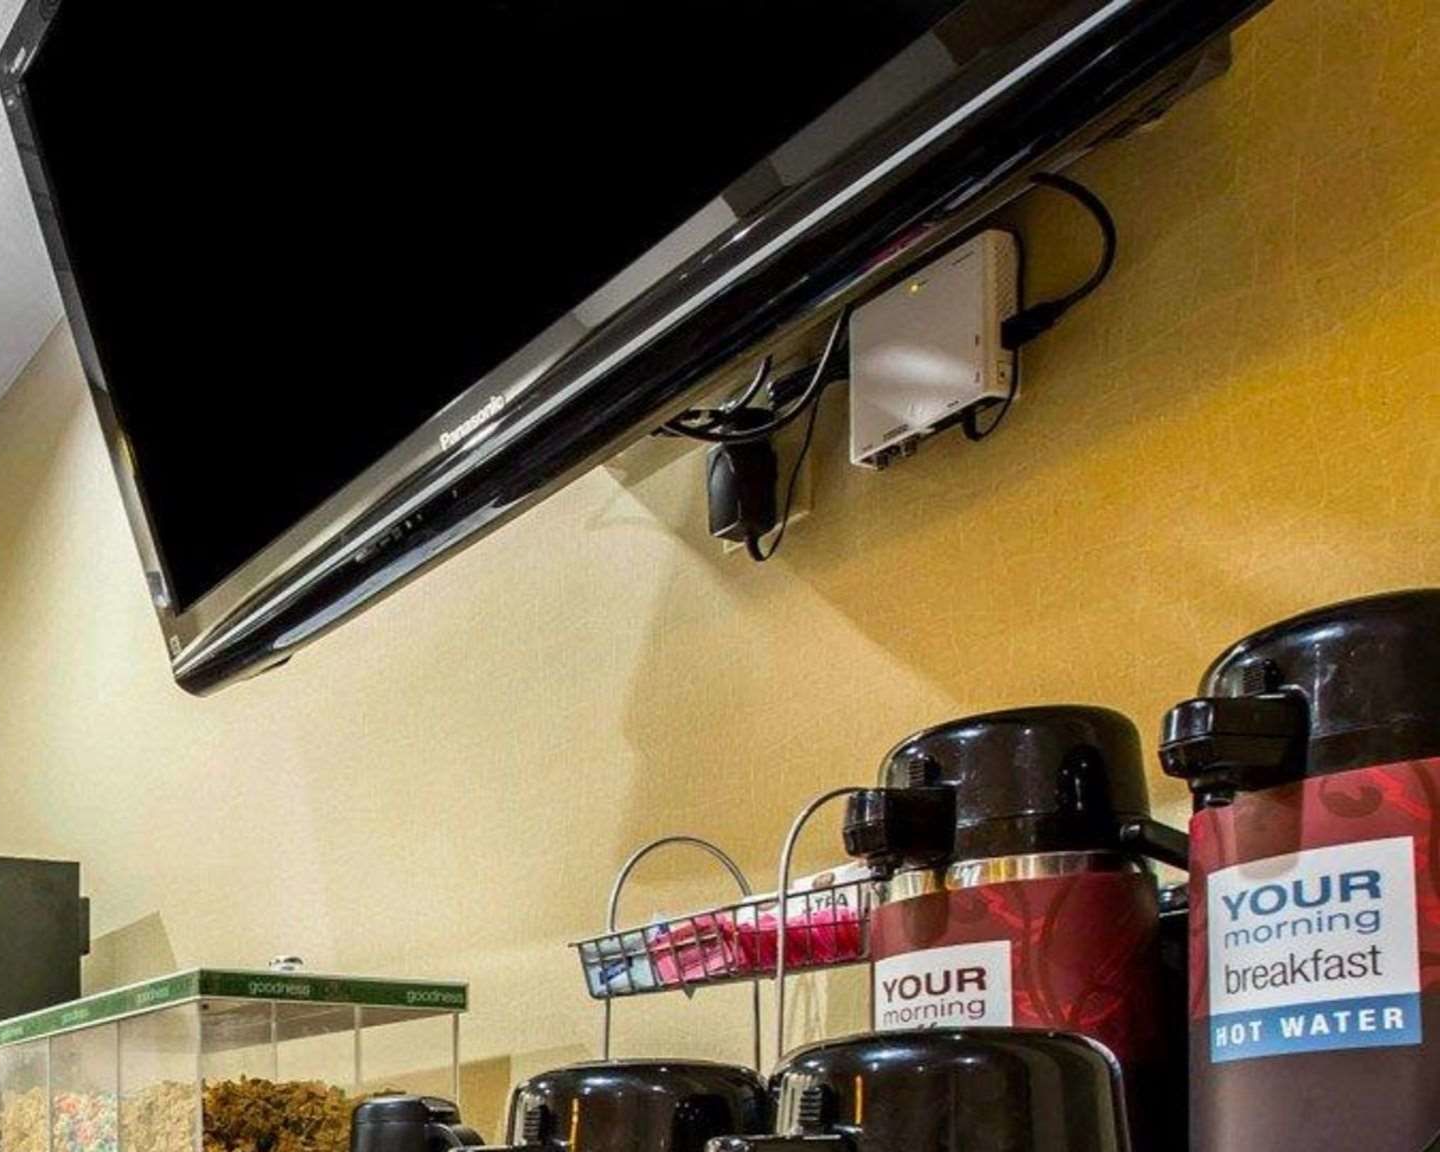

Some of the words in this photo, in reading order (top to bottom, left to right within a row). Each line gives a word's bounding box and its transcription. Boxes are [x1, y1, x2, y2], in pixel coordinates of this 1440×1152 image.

[439, 395, 505, 451] Panasonic
[1221, 869, 1382, 921] YOUR
[1224, 908, 1381, 949] morning
[882, 966, 987, 1003] YOUR
[1225, 944, 1383, 995] breakfast
[883, 999, 986, 1025] morning
[1215, 1020, 1263, 1047] HOT
[1279, 1006, 1405, 1039] WATER
